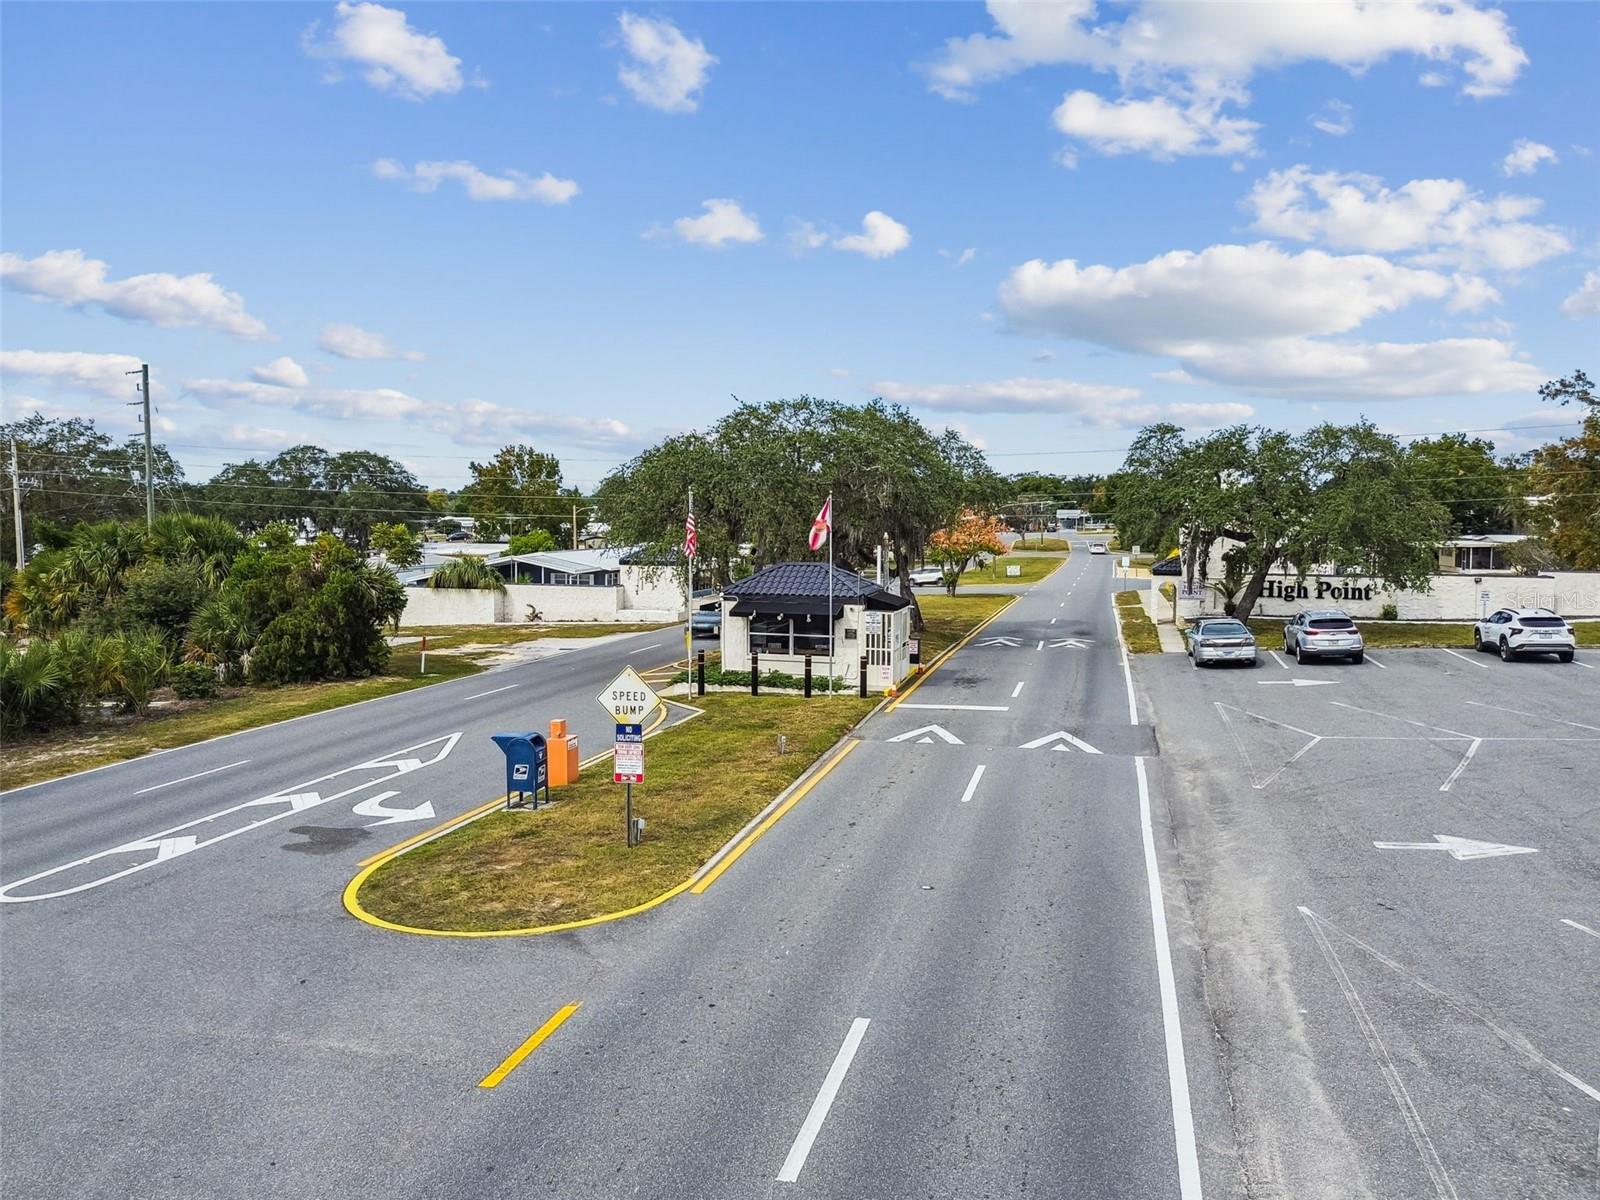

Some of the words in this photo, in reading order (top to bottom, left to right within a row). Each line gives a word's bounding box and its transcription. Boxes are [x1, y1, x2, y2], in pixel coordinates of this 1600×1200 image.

[1260, 580, 1308, 602] High
[1315, 581, 1373, 601] Point
[611, 690, 646, 701] SPEED
[615, 705, 644, 715] BUMP
[625, 725, 633, 734] NO
[616, 733, 642, 742] SOLICITING
